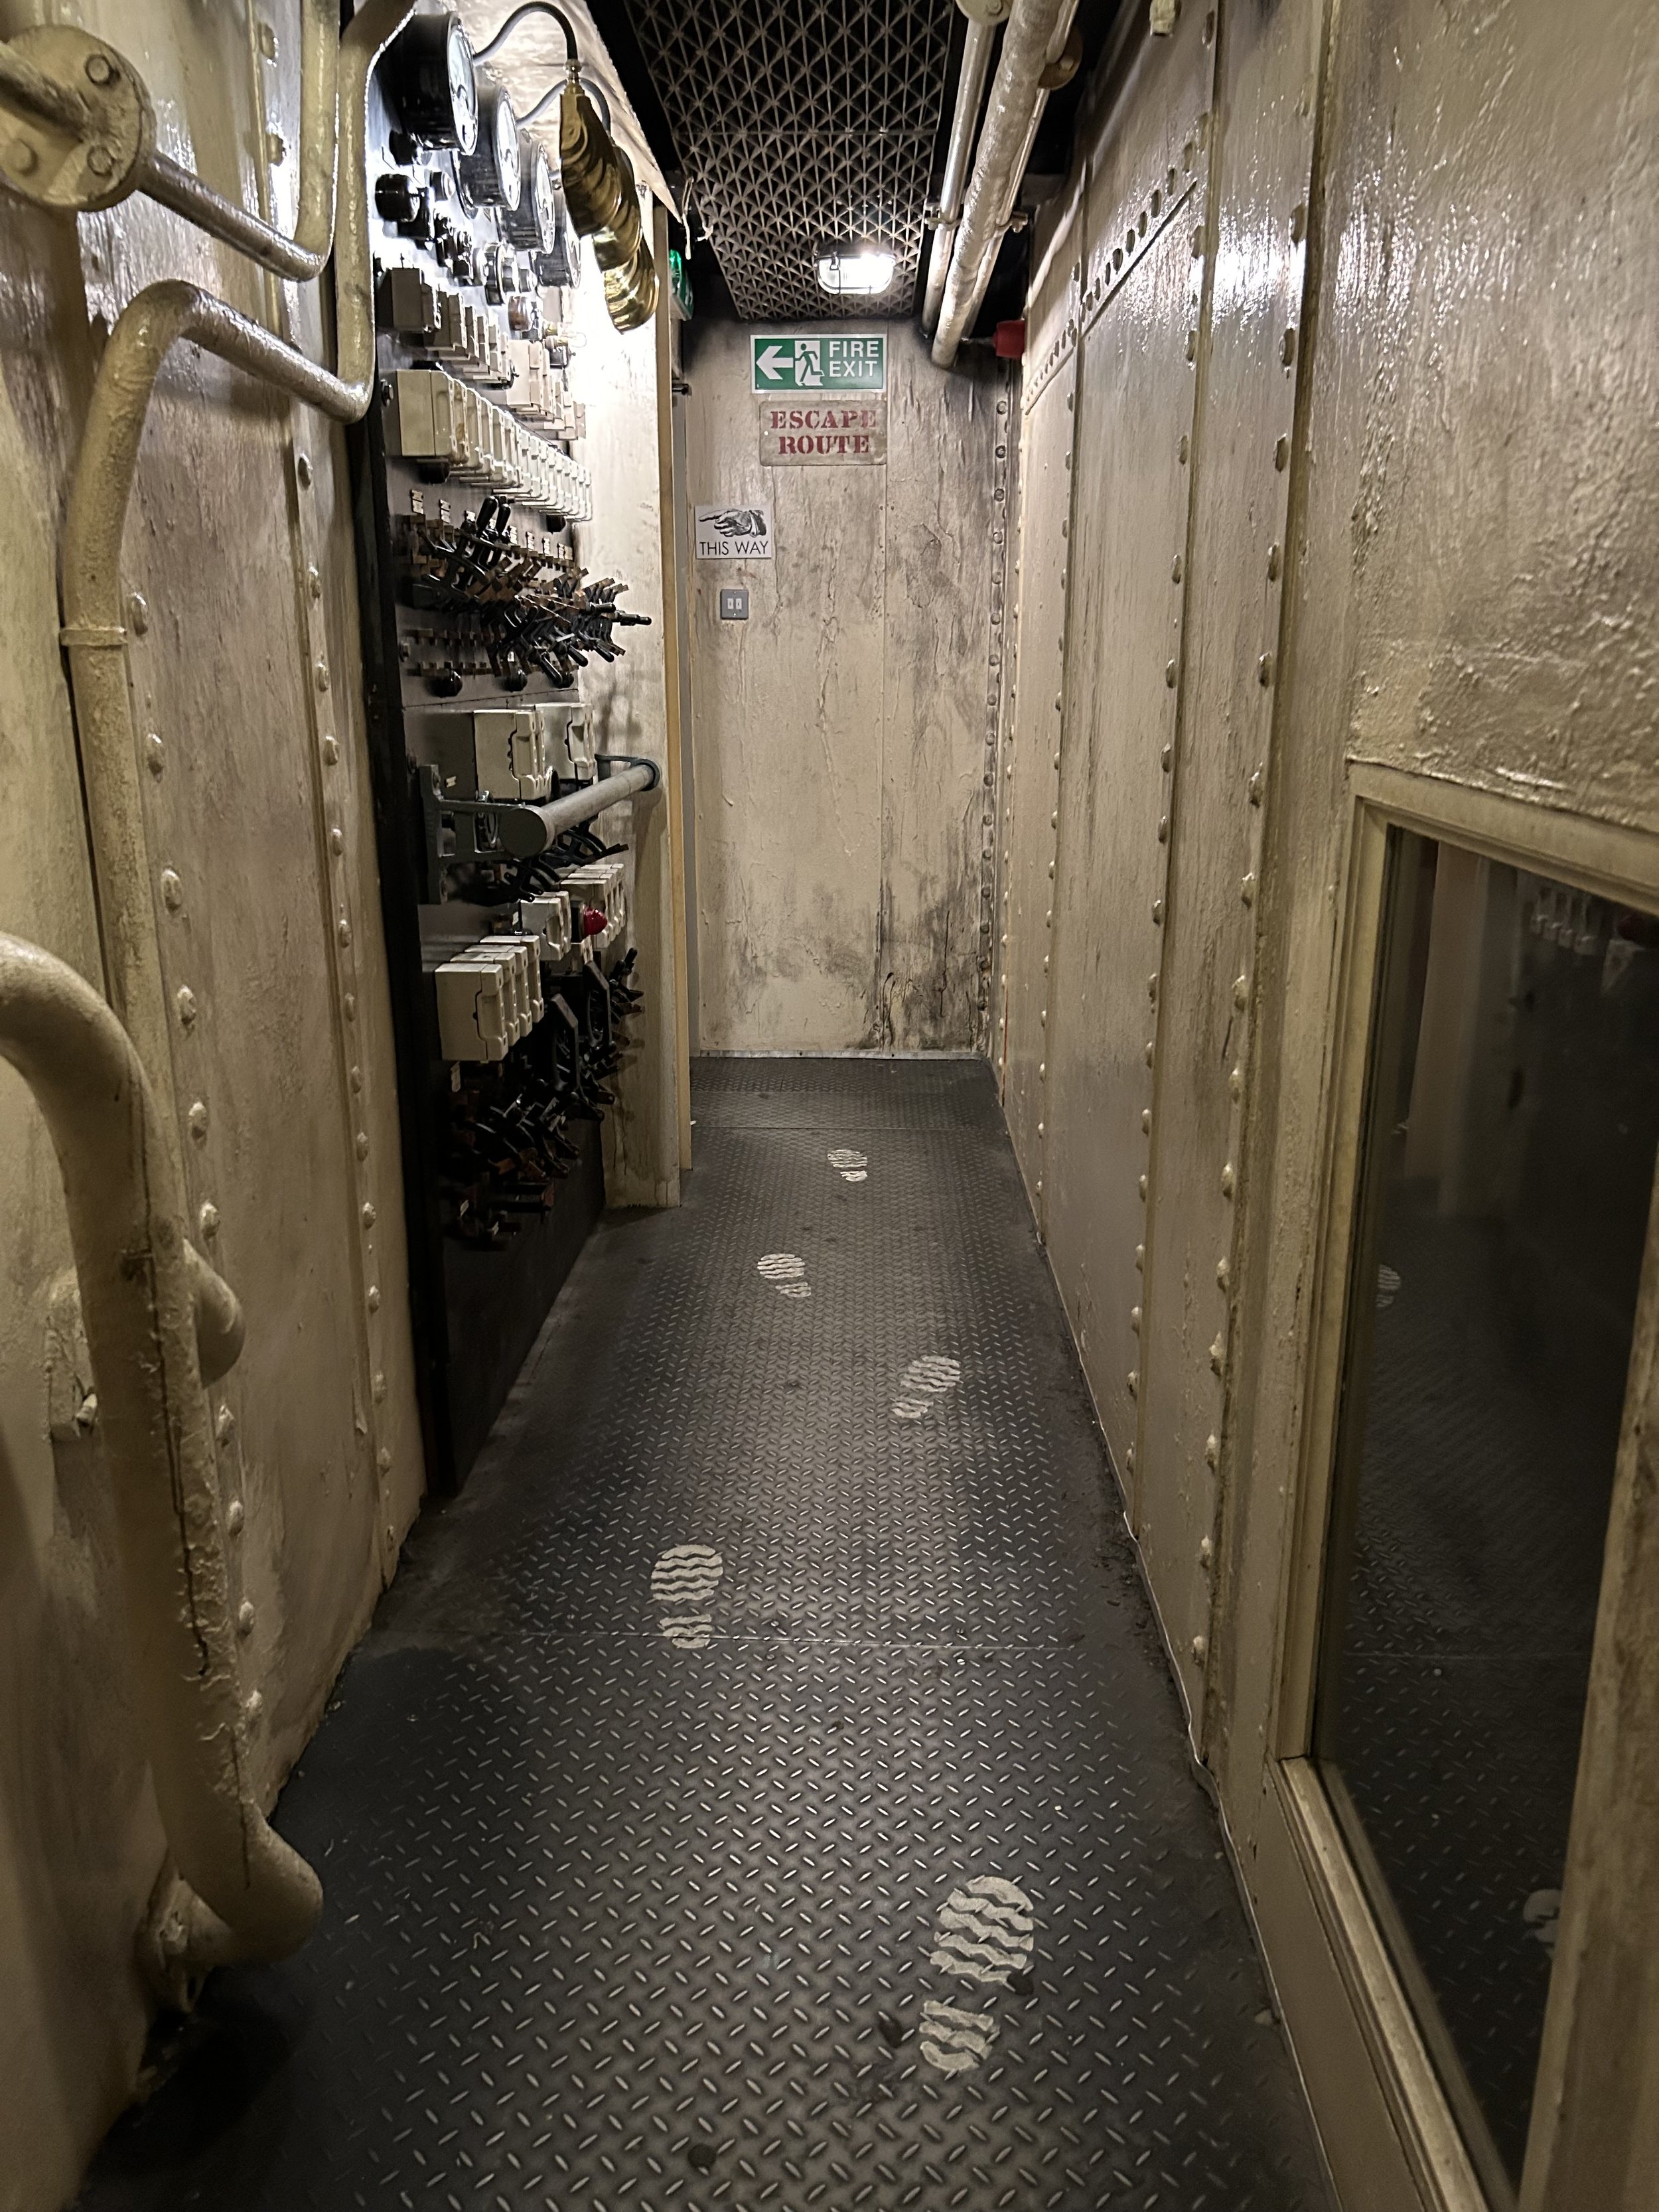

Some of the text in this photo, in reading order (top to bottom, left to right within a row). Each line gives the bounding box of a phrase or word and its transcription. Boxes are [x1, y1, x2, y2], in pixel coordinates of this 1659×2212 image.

[830, 340, 879, 358] FIRE
[830, 360, 877, 377] EXIT
[770, 410, 877, 429] ESCAPE
[778, 435, 869, 455] ROUTE
[699, 541, 768, 555] THIS WAY
